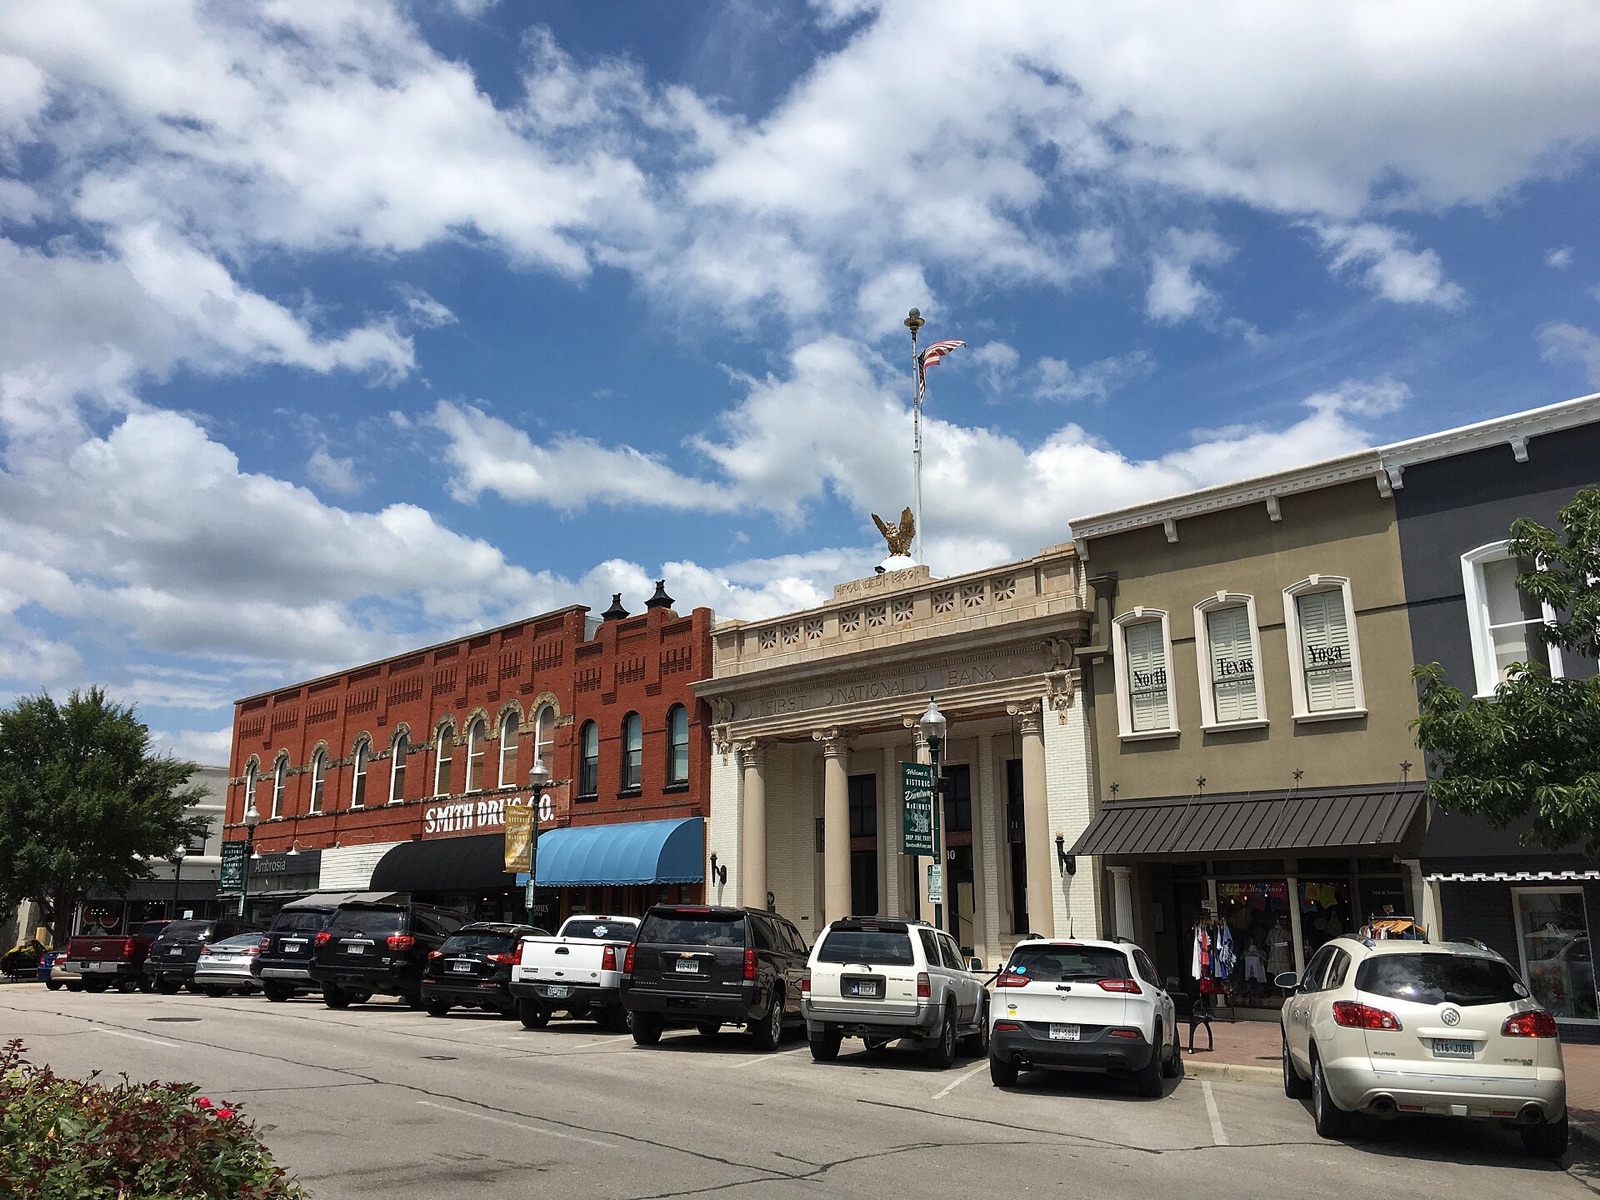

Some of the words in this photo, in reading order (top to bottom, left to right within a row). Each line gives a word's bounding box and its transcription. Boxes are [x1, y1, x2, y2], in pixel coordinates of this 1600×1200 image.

[841, 575, 883, 595] FOUNDED
[892, 569, 914, 584] 1869
[1133, 667, 1166, 688] North
[1216, 657, 1254, 676] Texas
[1307, 645, 1343, 665] Yoga
[766, 695, 807, 713] FIRST
[837, 678, 911, 702] NATIONAL
[947, 663, 997, 686] BANK
[425, 801, 474, 834] SMITH
[477, 797, 522, 827] DRU
[254, 857, 286, 873] Ambrosia
[1055, 984, 1072, 992] Jeep
